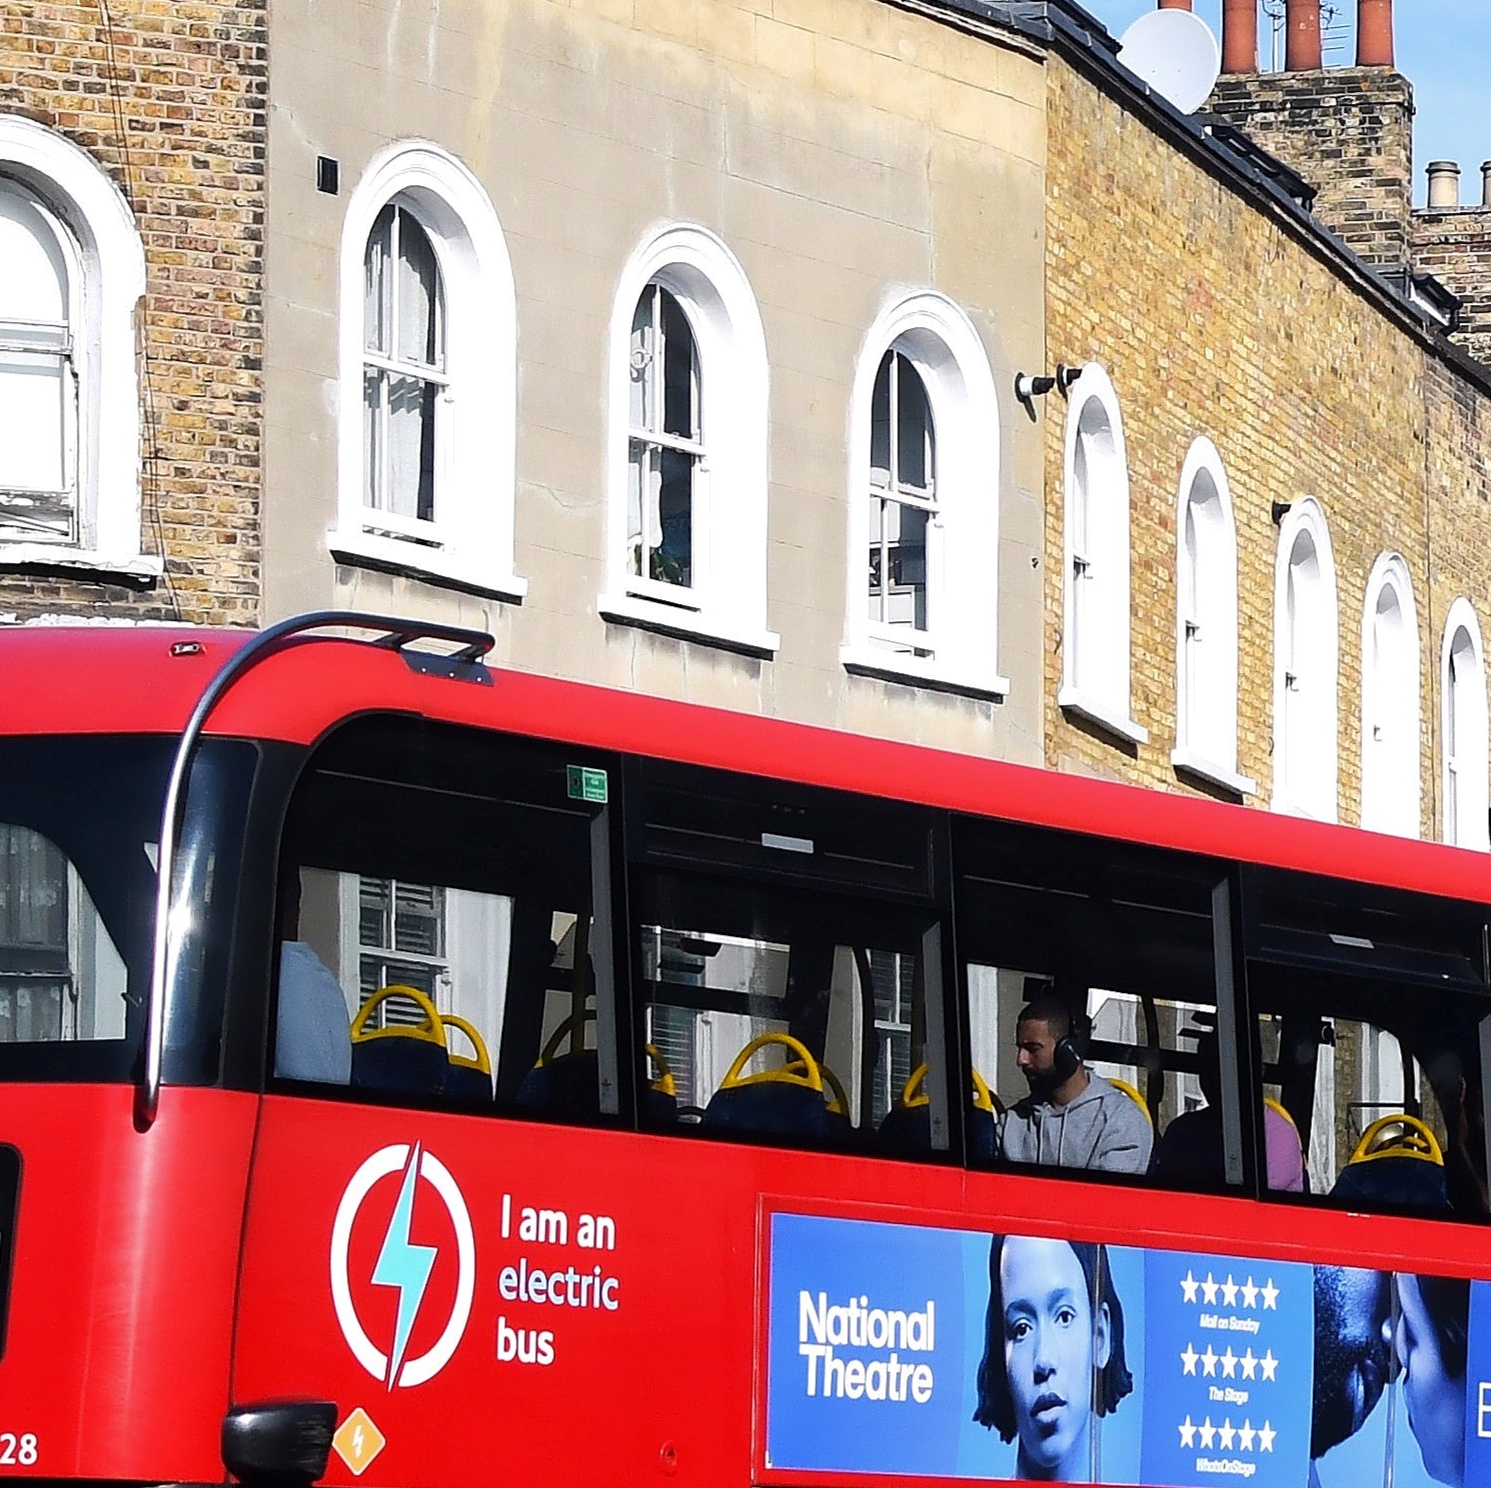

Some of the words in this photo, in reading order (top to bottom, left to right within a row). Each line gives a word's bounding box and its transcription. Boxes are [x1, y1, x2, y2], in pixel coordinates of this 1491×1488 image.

[501, 1194, 511, 1239] I
[519, 1207, 568, 1245] am
[577, 1214, 615, 1251] an
[498, 1257, 620, 1311] electric
[497, 1315, 555, 1366] bus
[799, 1290, 935, 1352] National
[1200, 1313, 1218, 1329] Mail
[1218, 1318, 1229, 1330] on
[1229, 1316, 1261, 1335] Sunday
[799, 1343, 935, 1404] Theatre
[1209, 1386, 1224, 1402] The
[1225, 1387, 1249, 1406] Stage
